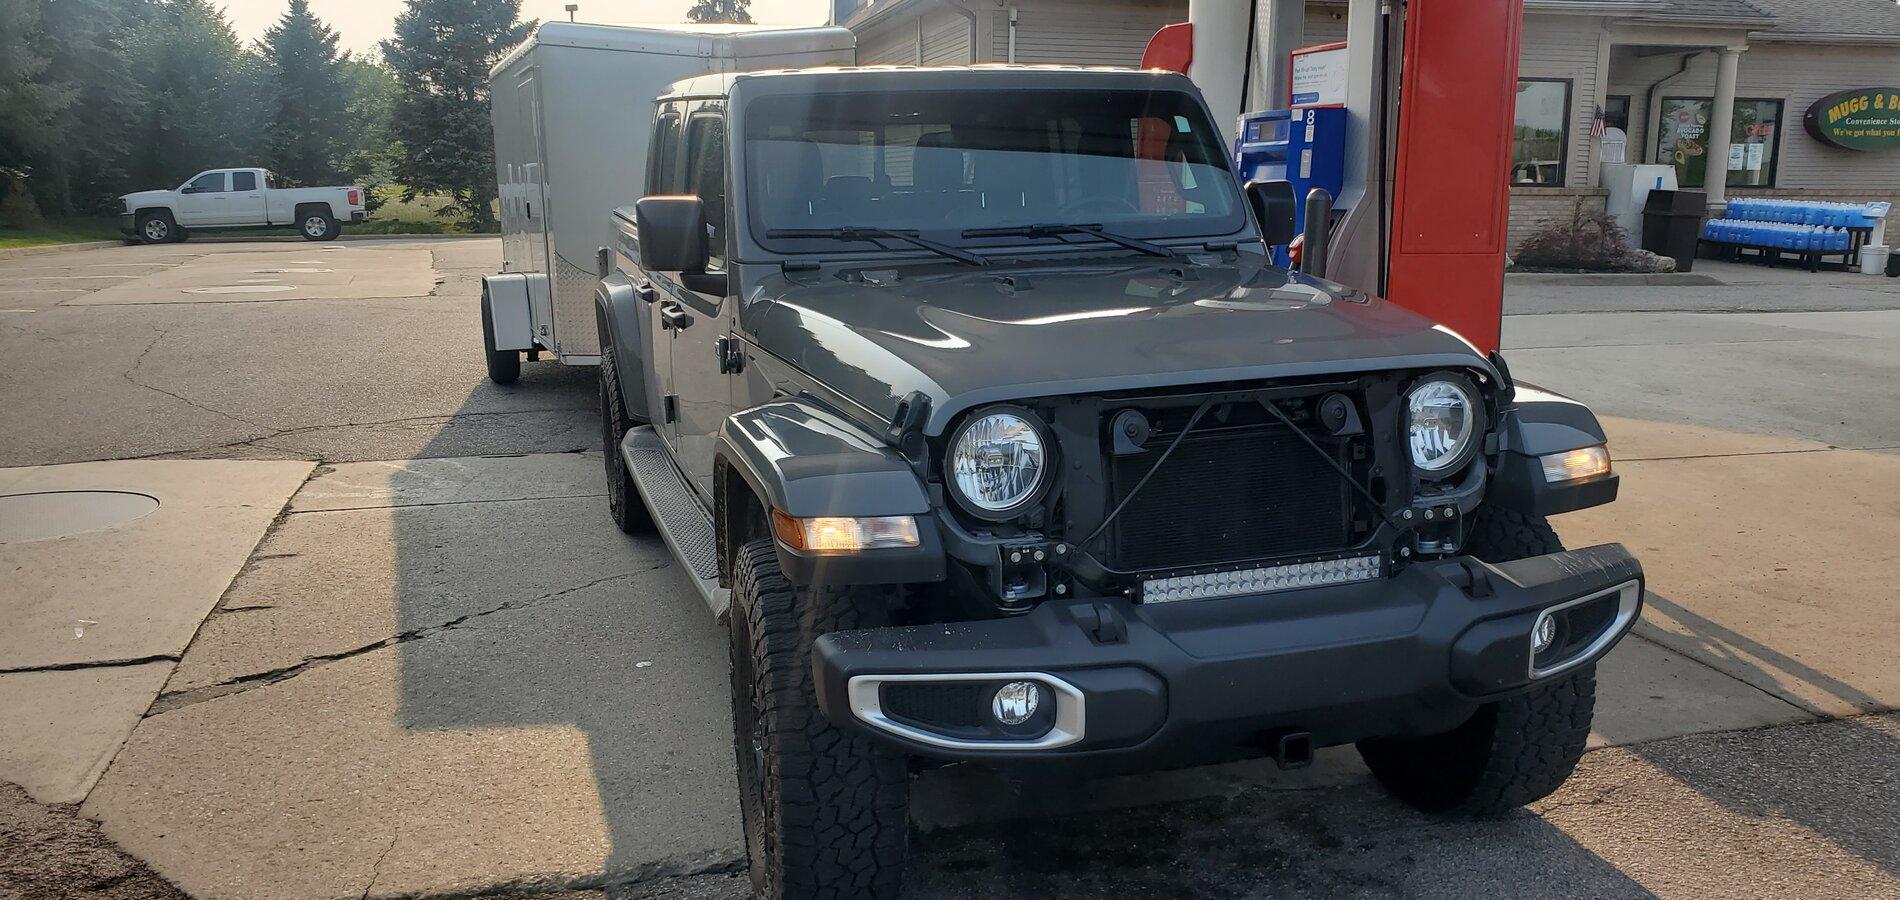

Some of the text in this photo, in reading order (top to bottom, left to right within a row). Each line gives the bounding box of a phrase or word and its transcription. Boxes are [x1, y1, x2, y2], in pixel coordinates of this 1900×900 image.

[1828, 96, 1869, 123] MUGG
[1874, 94, 1884, 109] &
[1307, 110, 1315, 125] 8
[1853, 128, 1865, 137] got
[1866, 128, 1881, 136] what
